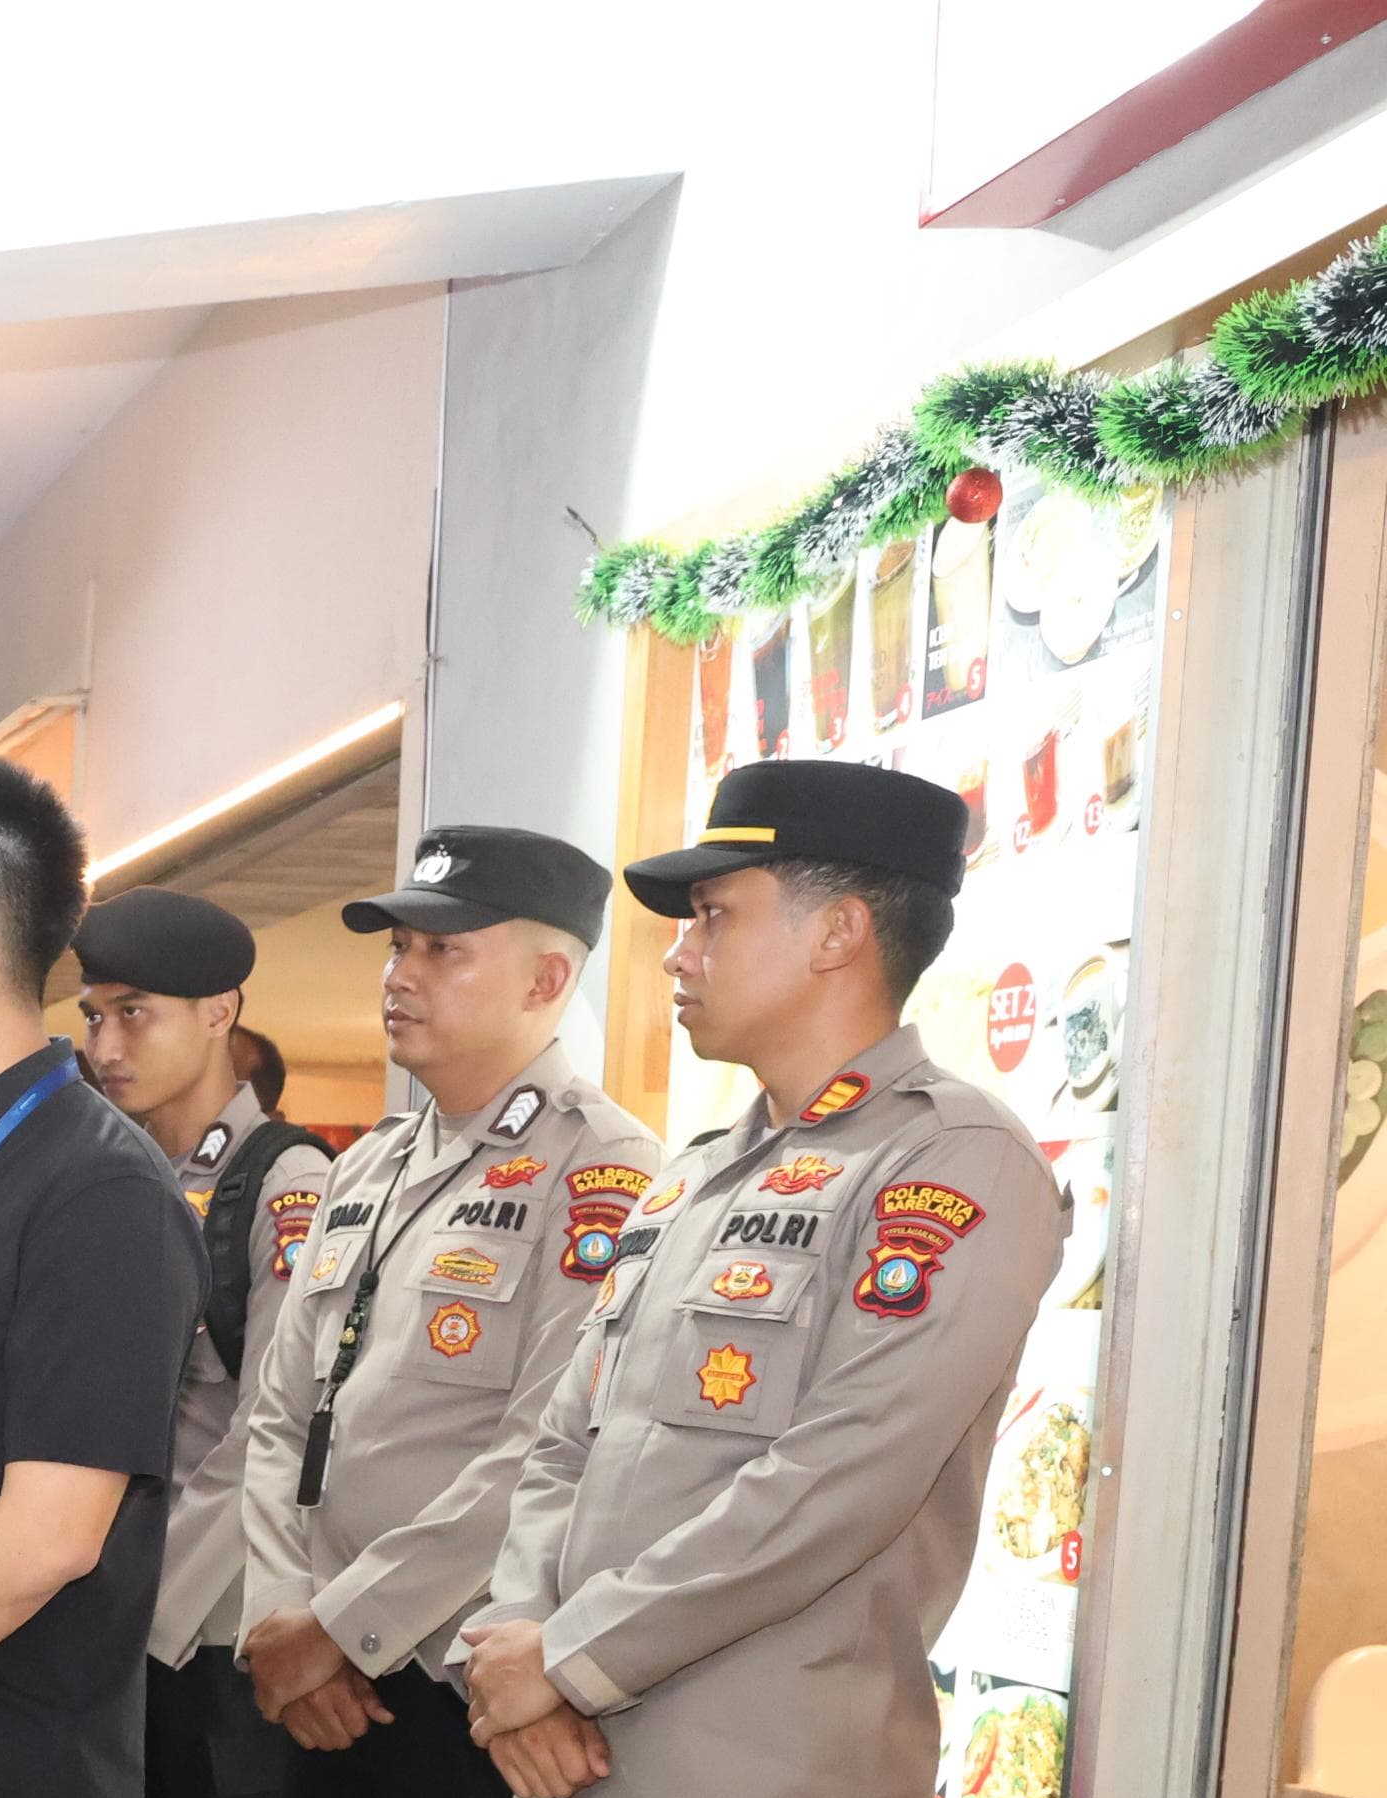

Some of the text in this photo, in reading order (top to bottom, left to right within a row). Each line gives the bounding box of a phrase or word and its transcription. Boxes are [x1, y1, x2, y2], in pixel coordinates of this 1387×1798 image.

[989, 986, 1024, 1022] SET
[272, 1191, 319, 1213] POLD
[447, 1200, 528, 1232] POLRI
[884, 1185, 975, 1220] POLRESTA
[884, 1199, 966, 1227] BARELANG
[720, 1212, 819, 1249] POLRI
[1066, 1541, 1078, 1570] 5
